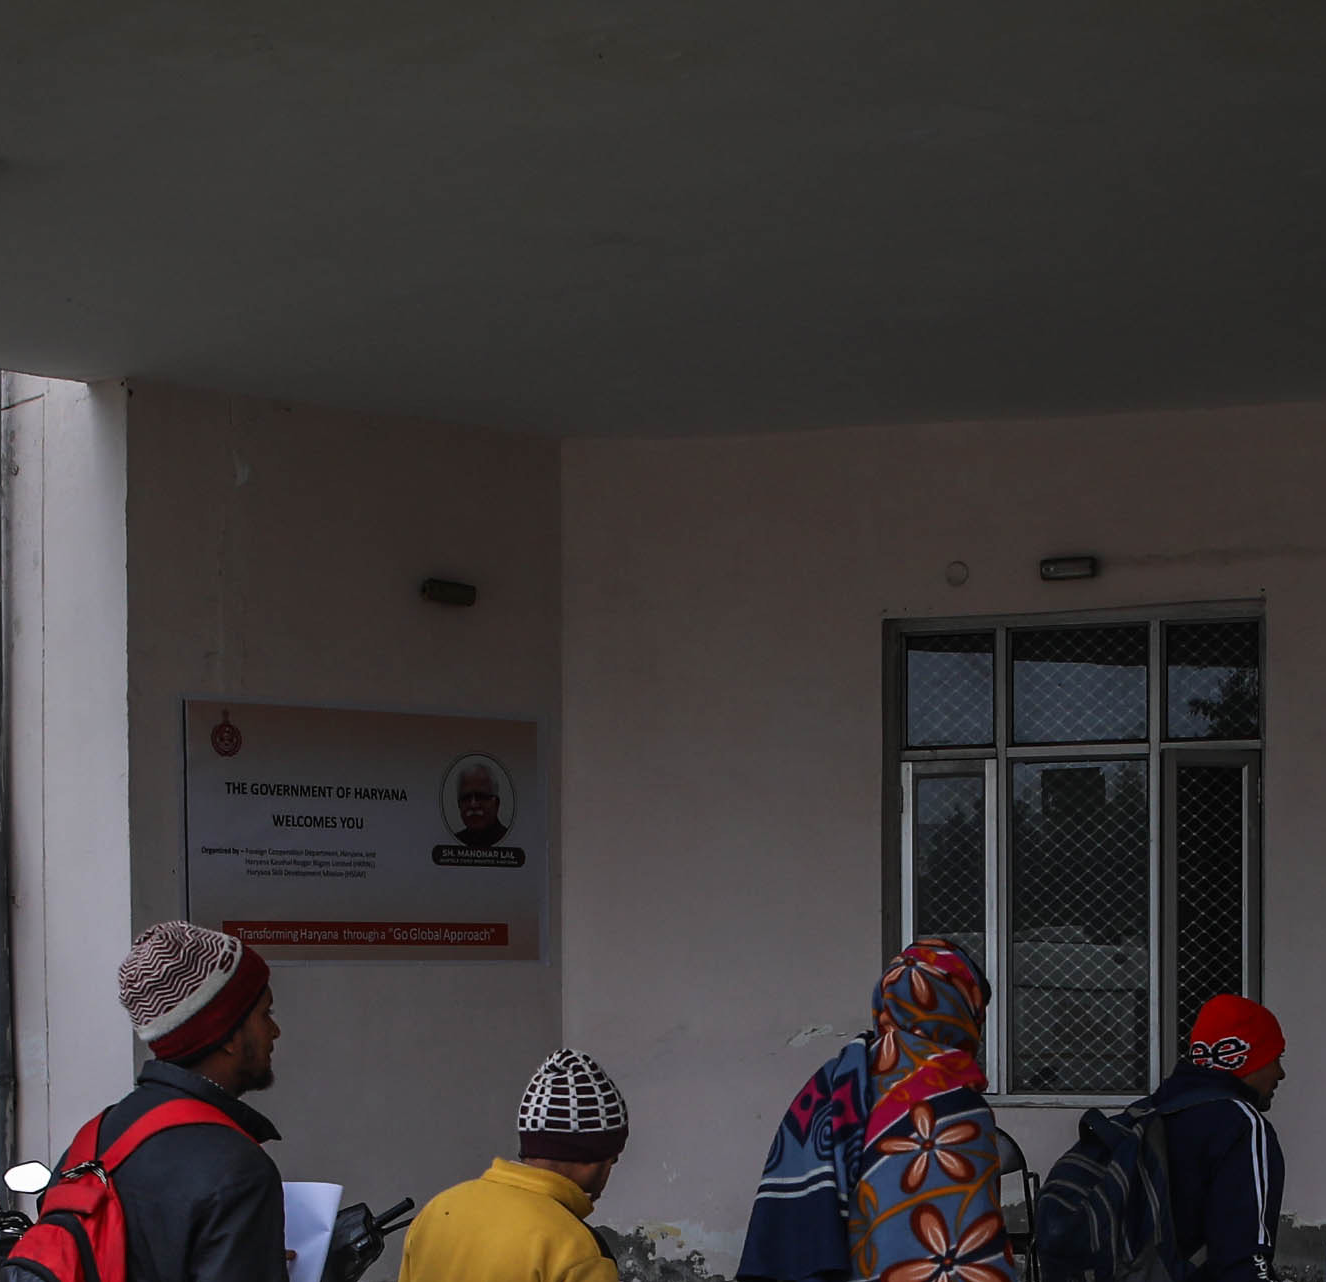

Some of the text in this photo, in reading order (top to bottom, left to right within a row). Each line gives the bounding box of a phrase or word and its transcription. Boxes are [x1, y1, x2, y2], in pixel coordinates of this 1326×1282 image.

[225, 781, 408, 801] THE GOVERNMENT OF HARYANA
[272, 814, 365, 830] WELCOMES YOU
[237, 927, 299, 943] Transforming
[300, 928, 339, 944] Haryana
[344, 928, 379, 943] through
[409, 928, 442, 942] Global
